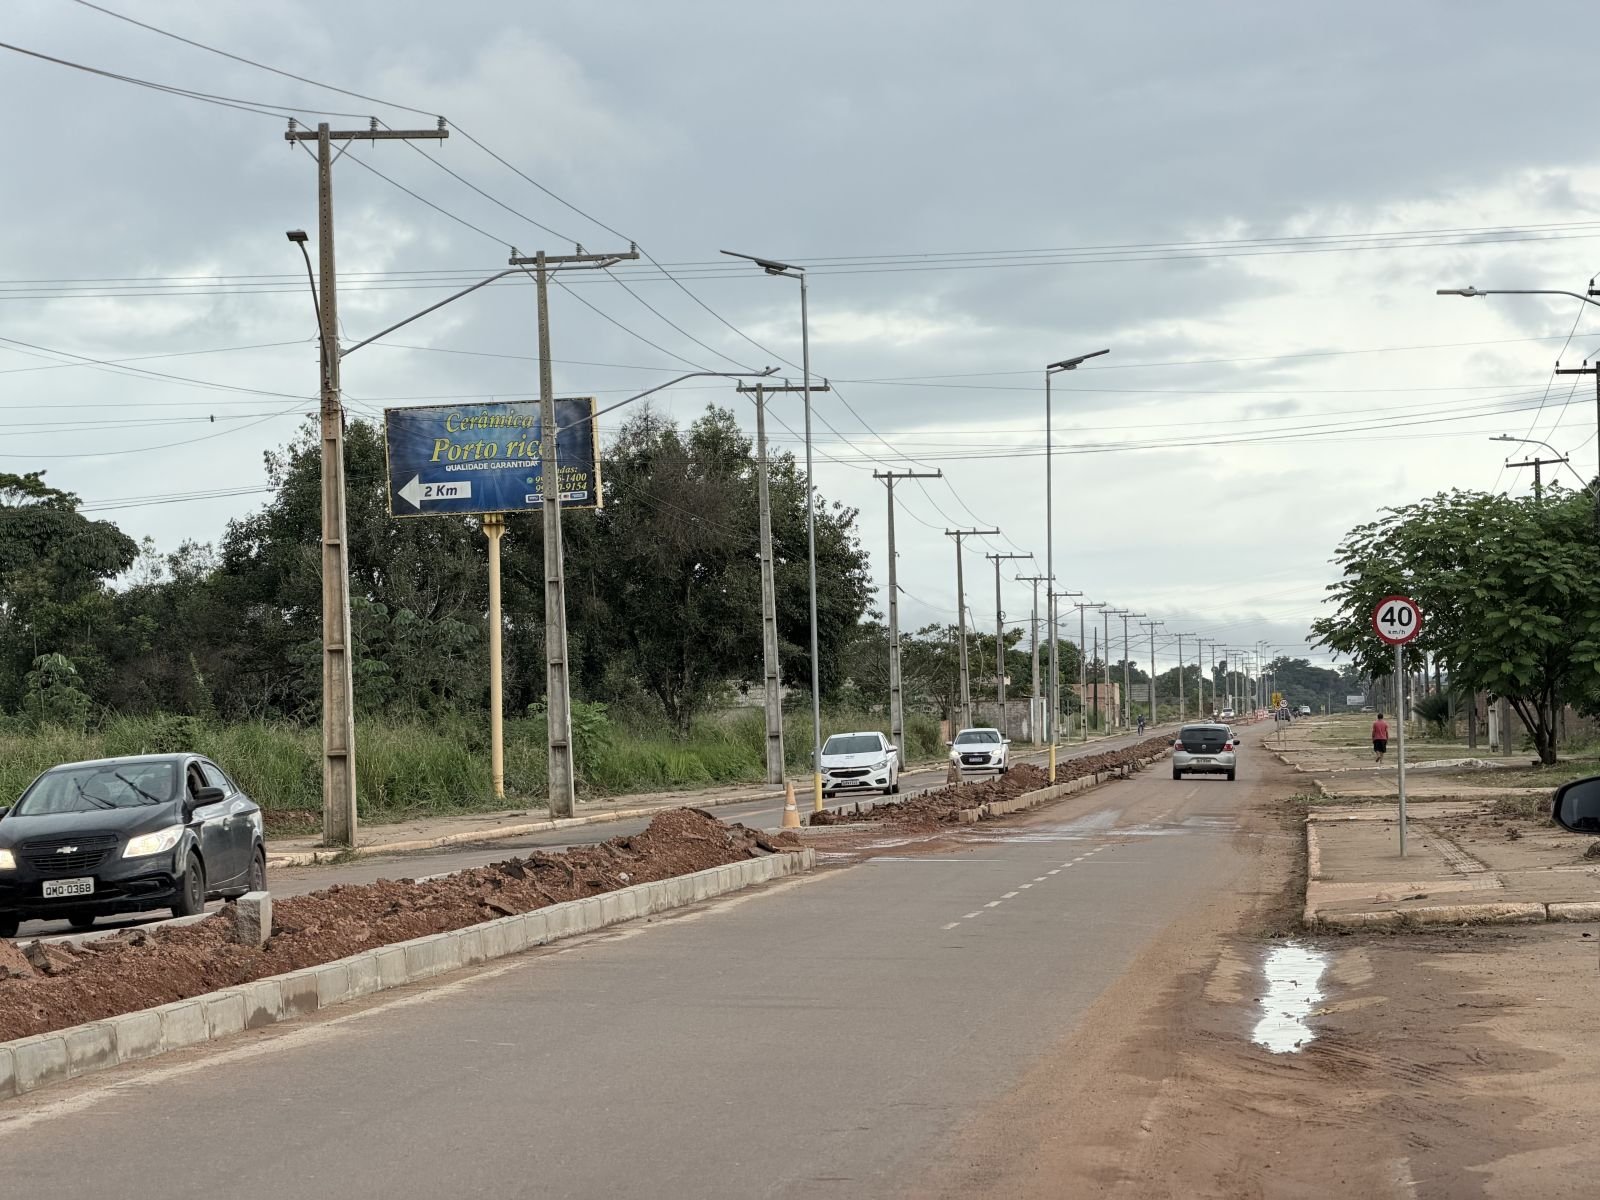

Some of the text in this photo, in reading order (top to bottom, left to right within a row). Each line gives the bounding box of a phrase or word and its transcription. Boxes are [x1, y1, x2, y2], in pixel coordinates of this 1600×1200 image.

[446, 409, 535, 433] Cerâmica
[429, 438, 498, 462] Porto
[445, 460, 536, 472] QUALIDADE GARANTIDA
[424, 484, 458, 497] 2 Km
[1381, 606, 1412, 626] 40
